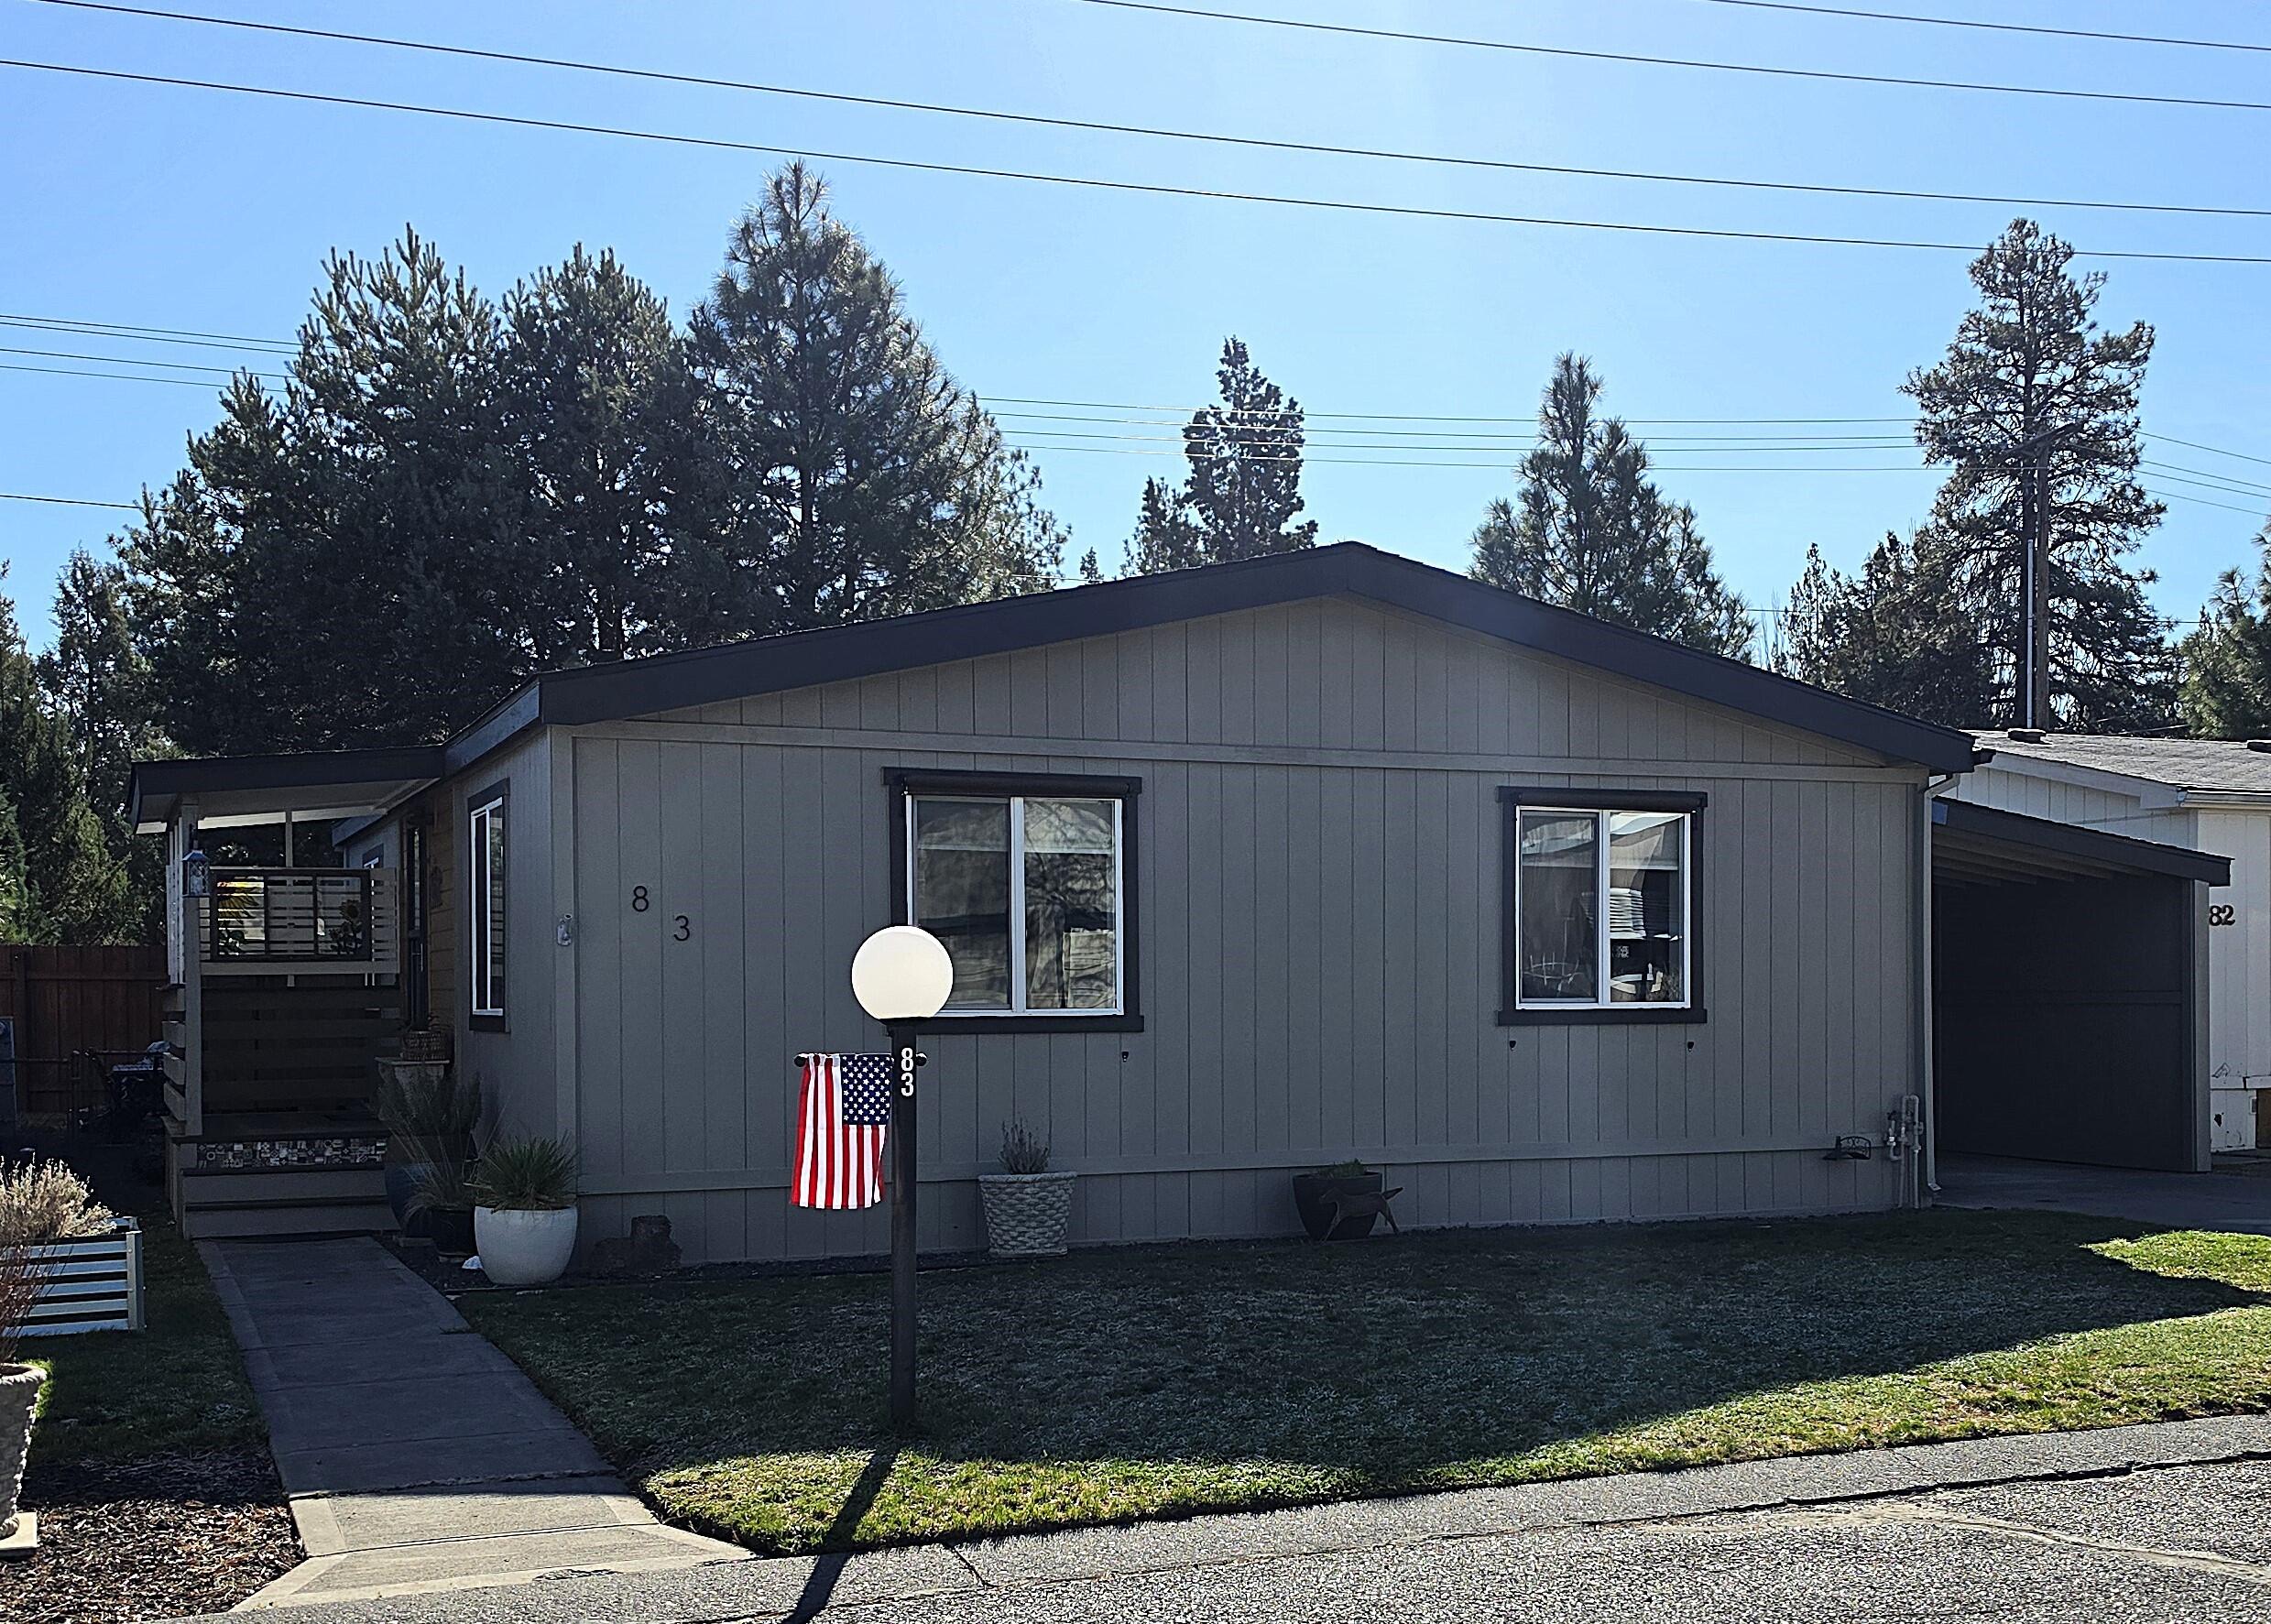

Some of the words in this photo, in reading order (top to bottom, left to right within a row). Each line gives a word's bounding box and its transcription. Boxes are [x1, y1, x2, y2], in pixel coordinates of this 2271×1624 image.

[632, 885, 690, 942] 83
[2209, 904, 2236, 927] 82
[901, 1047, 914, 1097] 83
